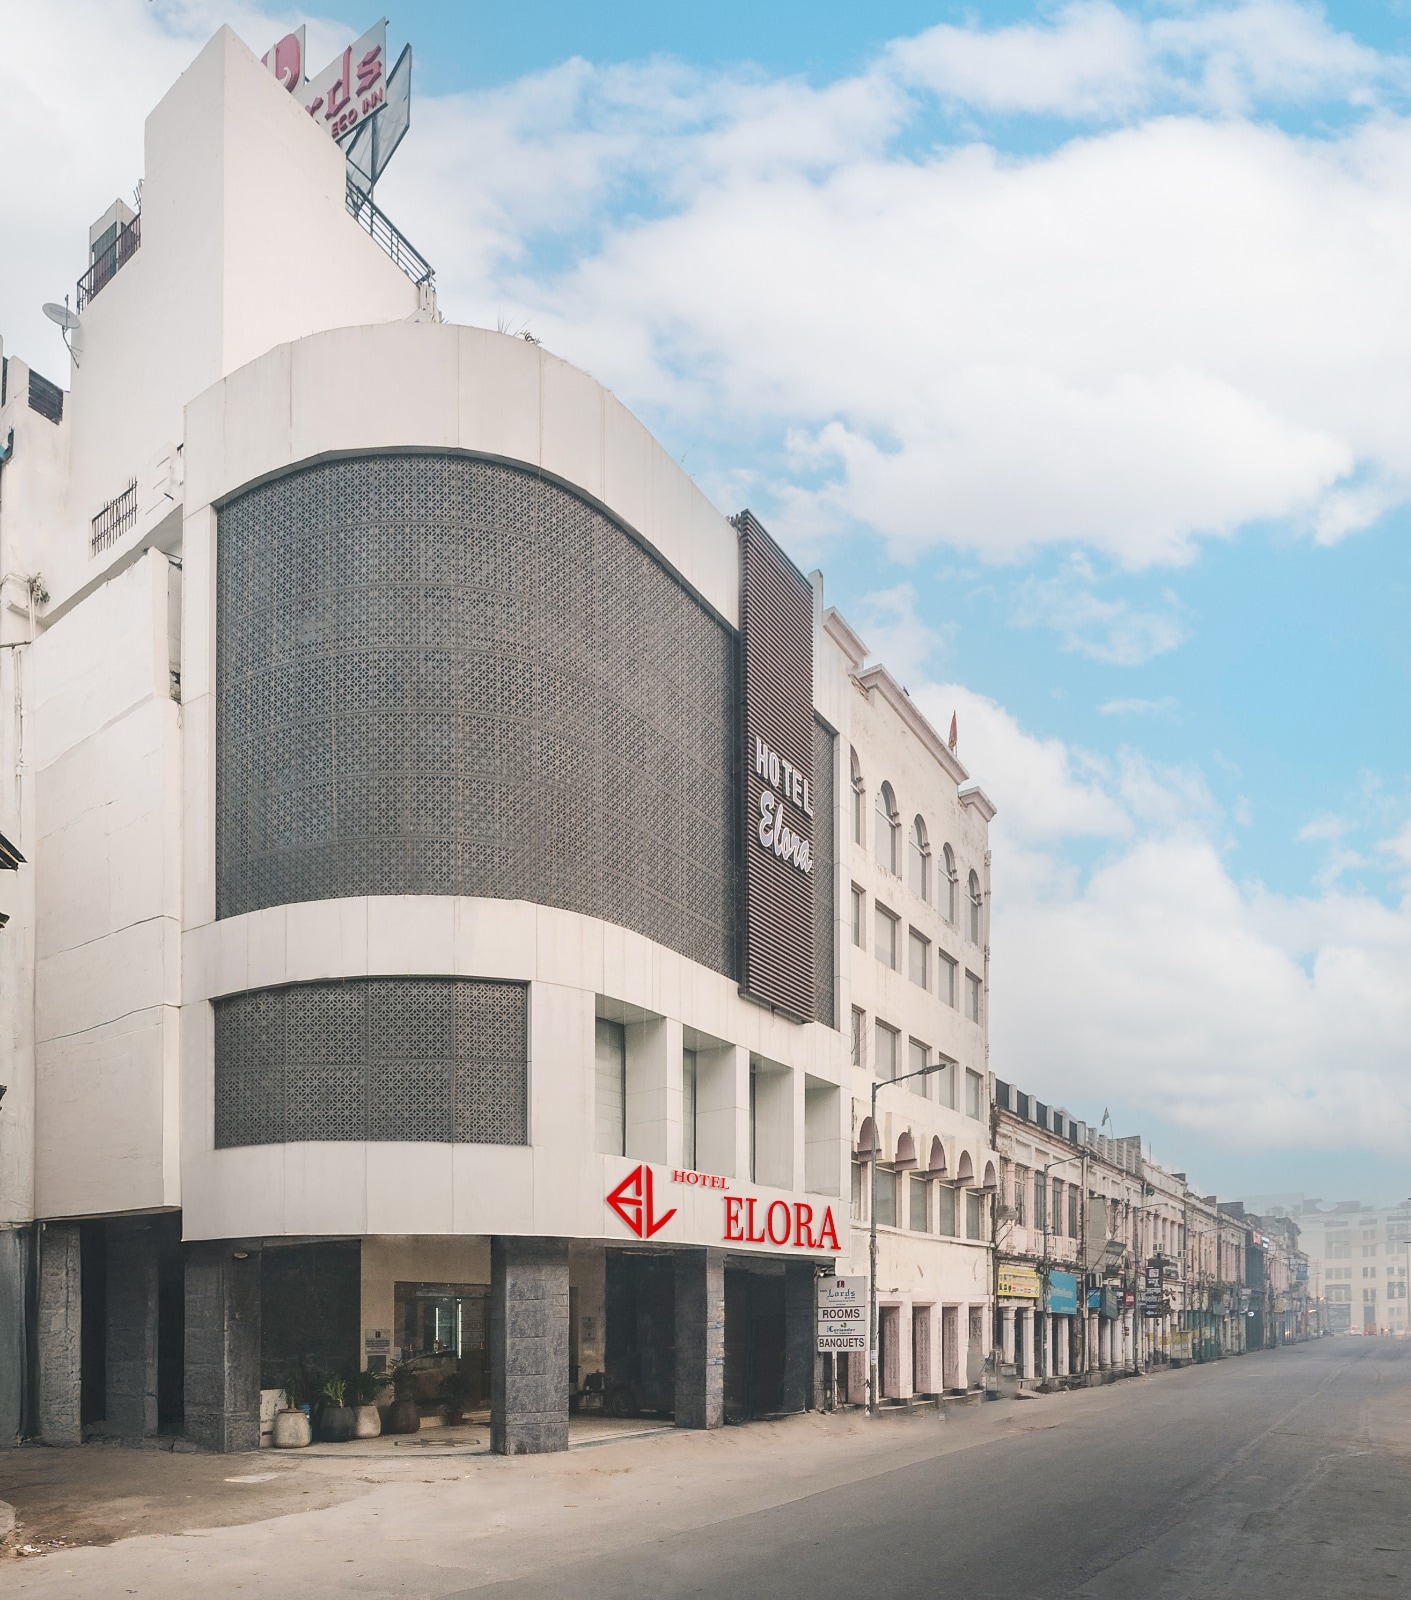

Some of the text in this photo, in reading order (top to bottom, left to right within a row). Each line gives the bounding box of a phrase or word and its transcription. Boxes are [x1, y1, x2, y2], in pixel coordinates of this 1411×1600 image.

[331, 87, 383, 139] ECO INN
[755, 736, 814, 818] HOTEL
[759, 790, 813, 873] Elora
[673, 1170, 730, 1190] HOTEL
[723, 1196, 842, 1250] ELORA
[827, 1288, 855, 1298] Lords
[822, 1309, 860, 1319] ROOMS
[819, 1338, 864, 1348] BANQUETS
